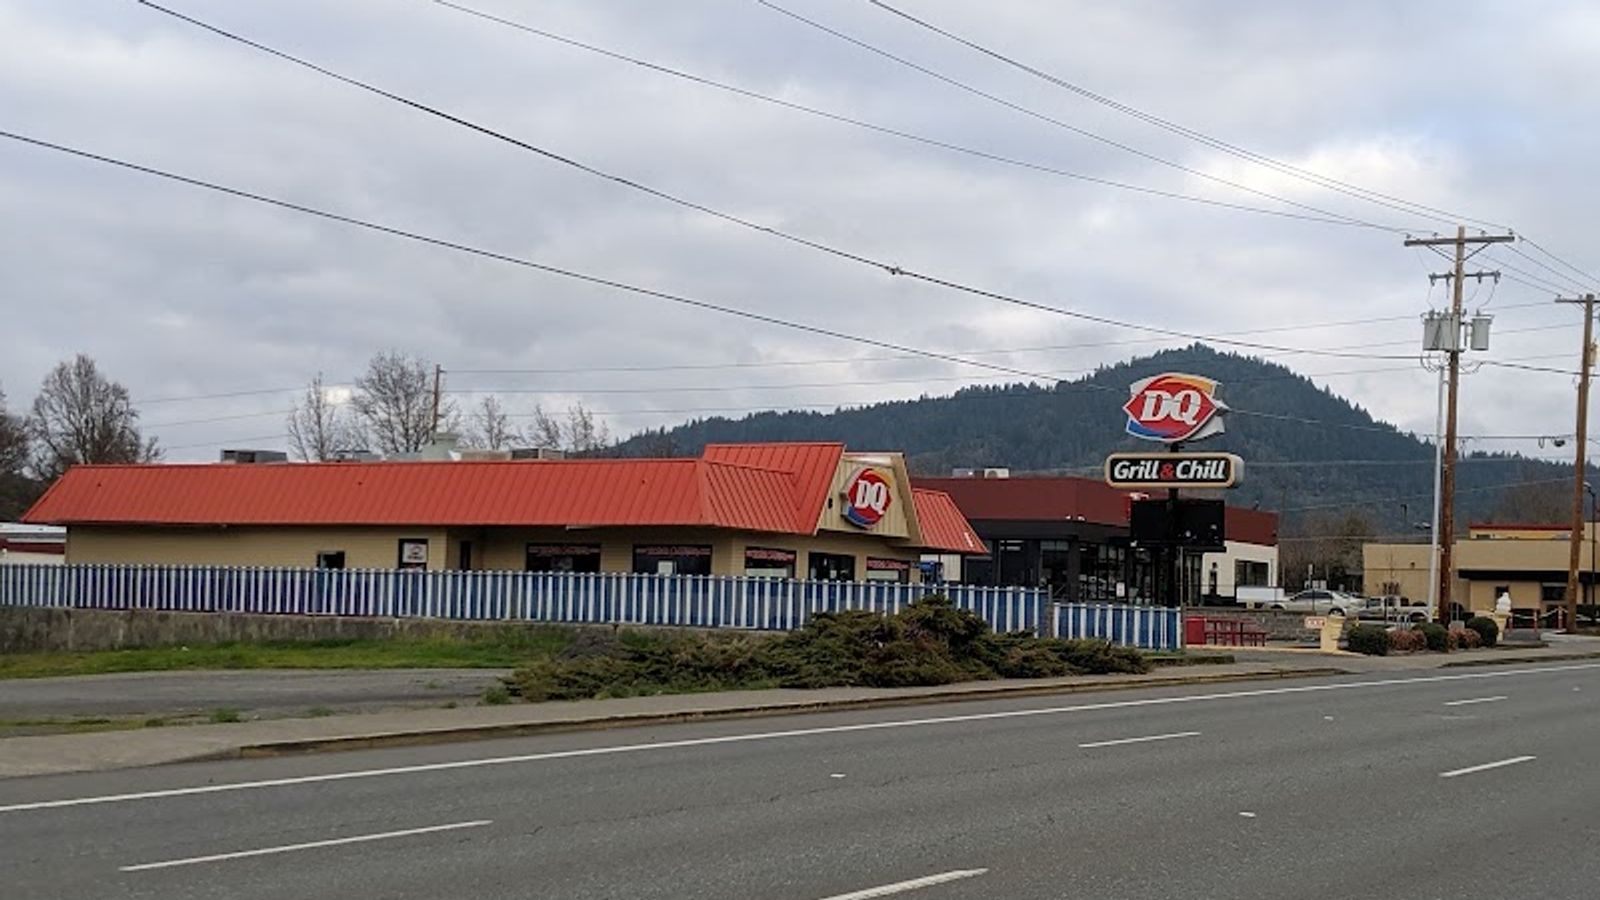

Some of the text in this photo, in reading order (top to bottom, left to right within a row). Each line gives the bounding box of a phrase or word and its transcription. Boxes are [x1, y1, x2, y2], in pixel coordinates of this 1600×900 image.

[1140, 390, 1202, 425] DQ
[1114, 460, 1159, 479] Grill
[1175, 460, 1226, 479] Chill
[854, 480, 888, 515] DQ
